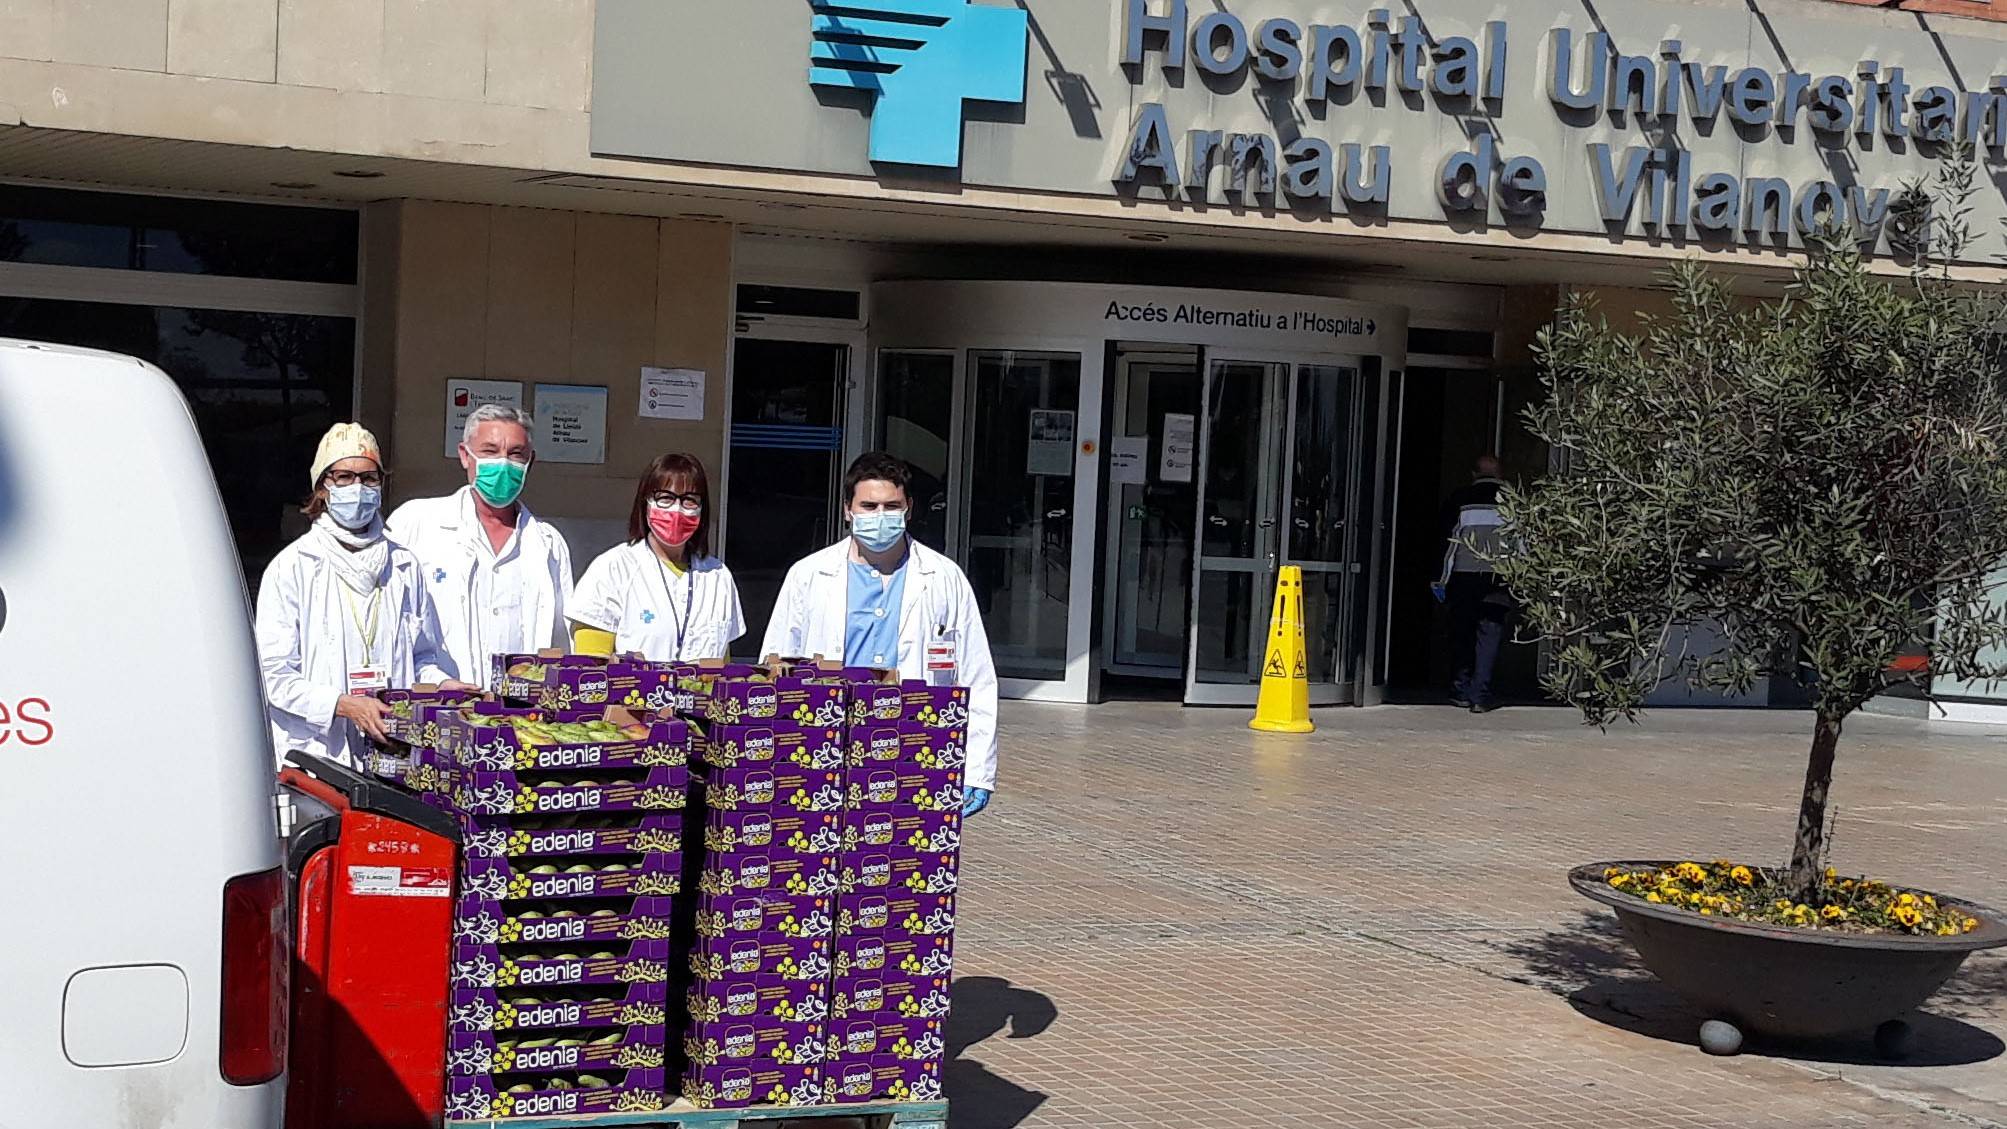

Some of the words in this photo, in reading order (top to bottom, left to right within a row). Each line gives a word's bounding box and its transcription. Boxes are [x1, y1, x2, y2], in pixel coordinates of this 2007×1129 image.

[1120, 0, 1507, 101] Hospital
[1112, 103, 1391, 202] Arnau
[1434, 133, 1547, 216] de
[1104, 300, 1168, 322] Accés
[1173, 304, 1272, 329] Alternatiu
[1276, 315, 1288, 330] a
[1292, 311, 1364, 338] l'Hospital
[539, 745, 600, 767] edenia
[538, 788, 600, 811] edenia
[531, 830, 594, 853] edenia
[532, 874, 594, 897] edenia
[523, 918, 584, 941] edenia
[520, 961, 581, 984] edenia
[518, 1004, 579, 1027] edenia
[516, 1046, 578, 1069] edenia
[515, 1091, 577, 1114] edenia
